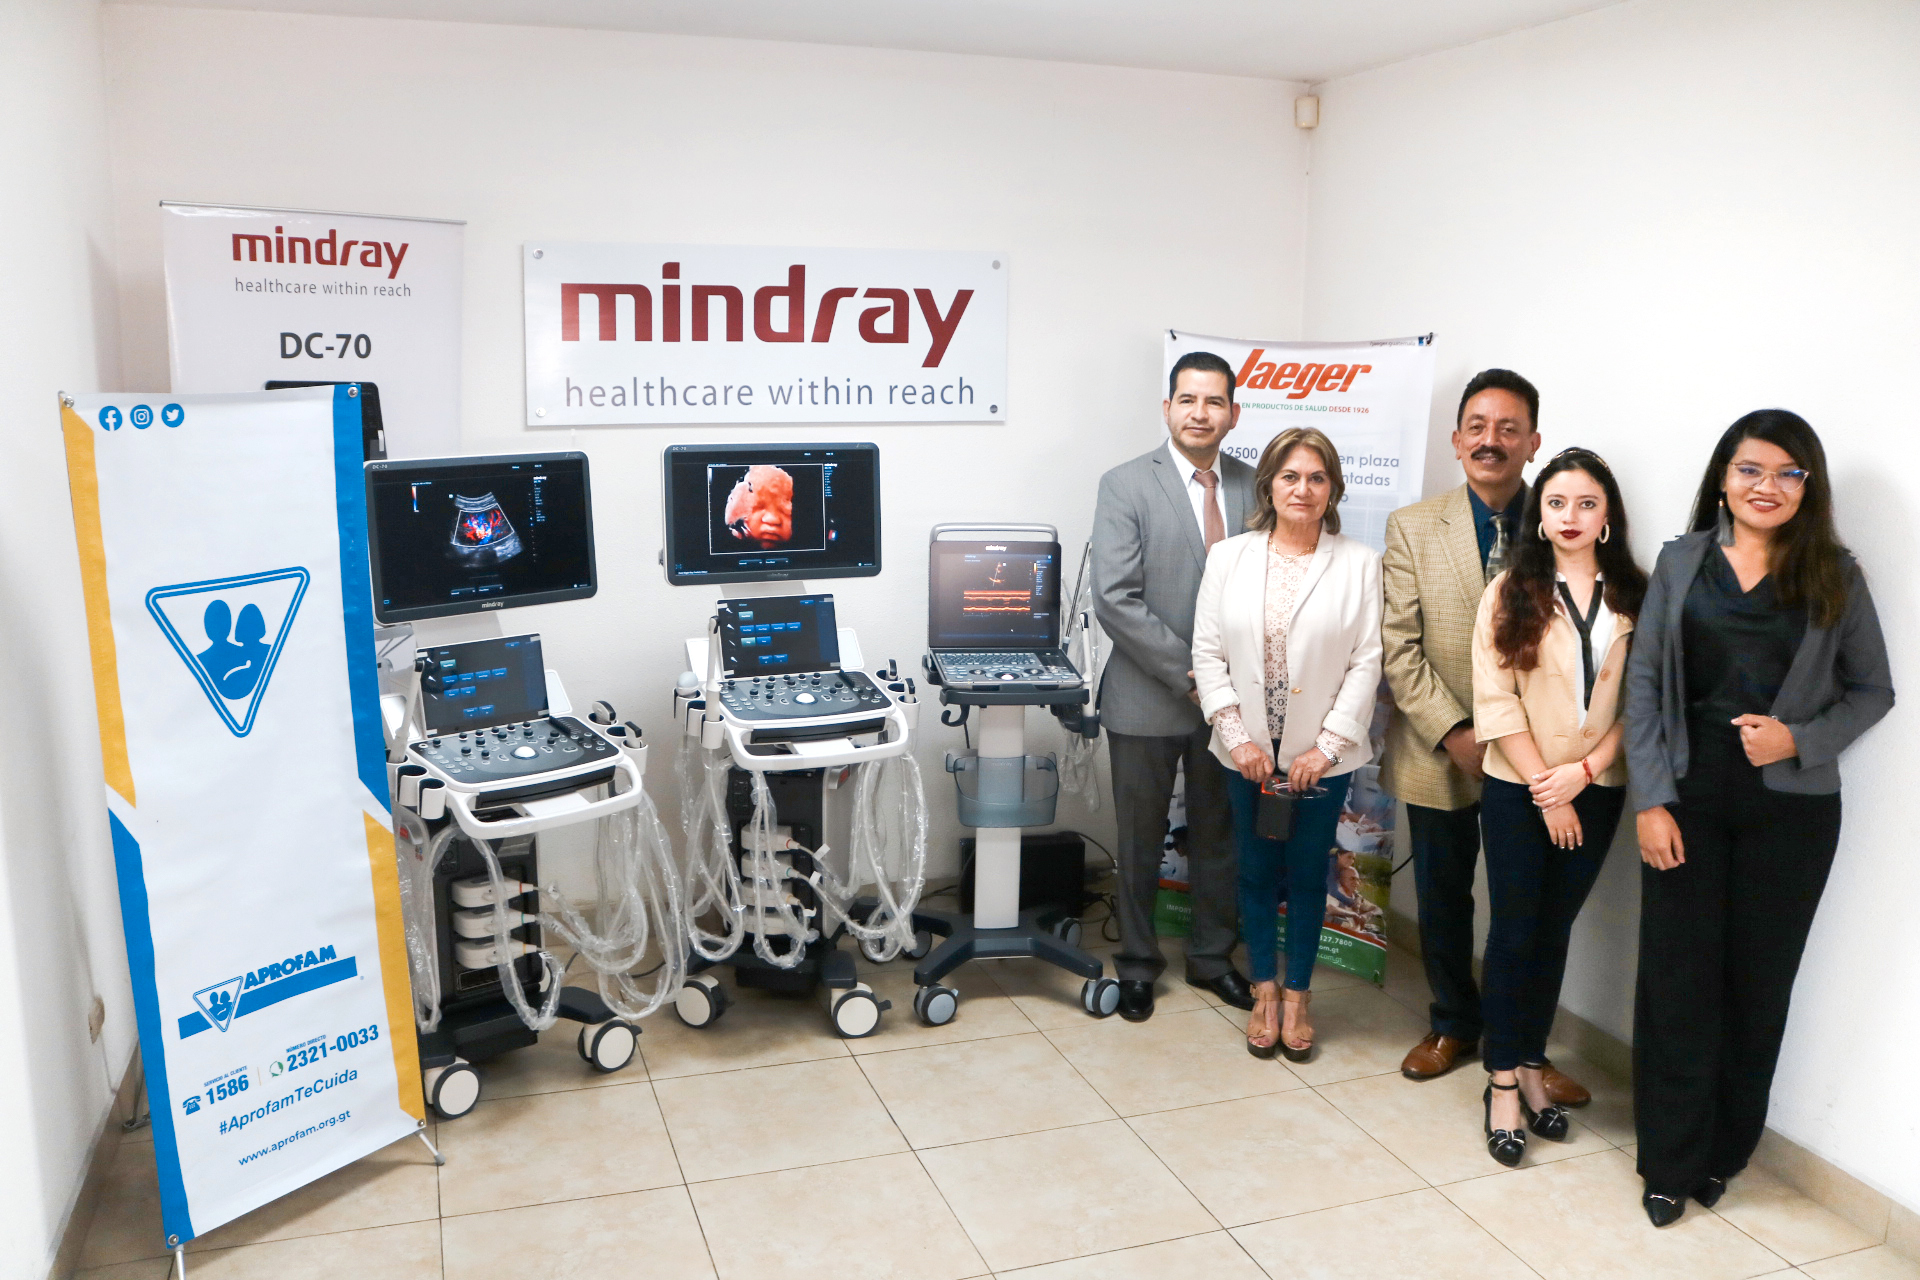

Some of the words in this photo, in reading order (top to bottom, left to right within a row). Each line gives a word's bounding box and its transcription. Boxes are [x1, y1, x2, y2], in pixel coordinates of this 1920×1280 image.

[232, 225, 409, 279] mindray
[235, 277, 317, 294] healthcare
[323, 281, 368, 296] within
[373, 284, 412, 297] reach
[561, 262, 975, 368] mindray
[280, 332, 372, 359] DC-70
[1235, 349, 1373, 400] Jaeger
[566, 377, 754, 407] healthcare
[769, 378, 873, 406] within
[890, 377, 975, 406] reach
[1252, 403, 1293, 411] PRODUCTOS
[1329, 405, 1351, 413] DESDE
[1353, 406, 1369, 414] 1926
[1359, 454, 1399, 468] plaza
[481, 601, 504, 609] mindray
[243, 944, 337, 990] APROFAM
[286, 1024, 380, 1072] 2321-0033
[307, 1034, 327, 1046] DIRECTO
[203, 1075, 224, 1087] SERVICIO
[230, 1065, 248, 1076] CLIENTE
[205, 1074, 250, 1105] 1586
[219, 1069, 359, 1136] #AprofamTeCuida
[238, 1109, 351, 1167] www.aprofam.org.gt
